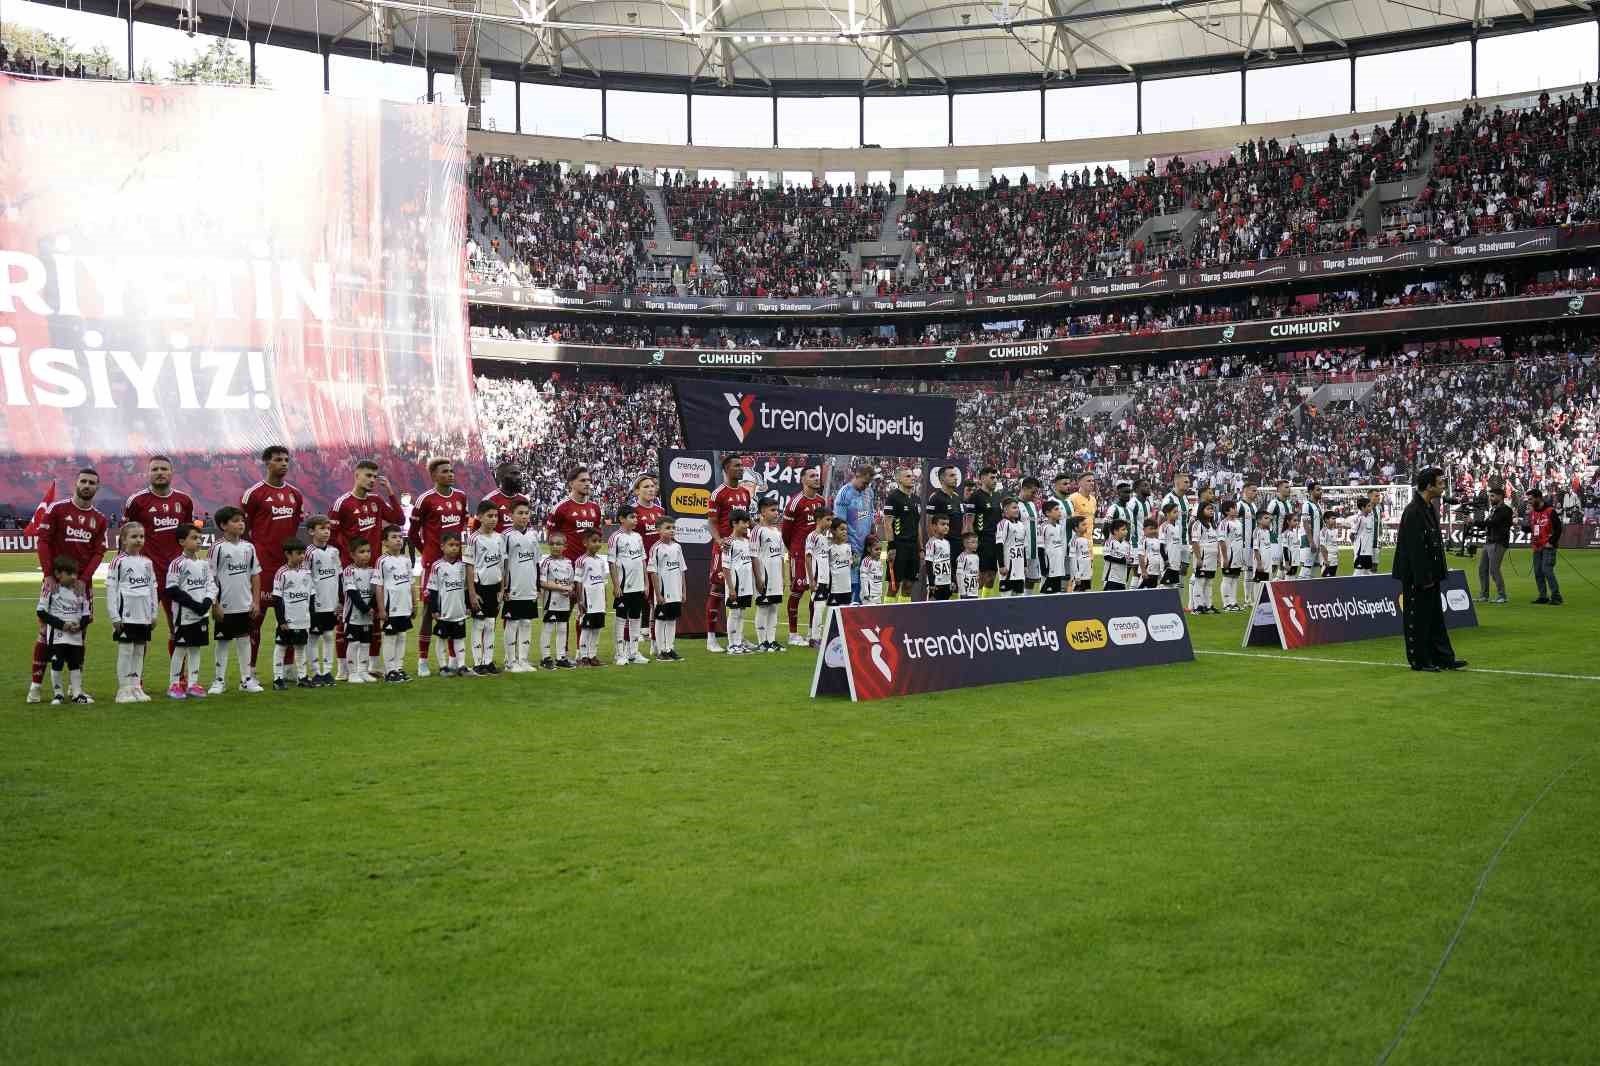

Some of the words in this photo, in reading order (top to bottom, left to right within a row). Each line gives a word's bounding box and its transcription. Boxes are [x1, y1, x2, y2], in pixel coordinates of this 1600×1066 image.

[1322, 259, 1345, 270] Tüpraş
[1346, 254, 1384, 267] Stadyumu
[1200, 273, 1221, 282] Tüpraş
[1222, 268, 1256, 281] Stadyumu
[760, 402, 854, 438] trendyol
[272, 506, 293, 515] beko
[153, 516, 179, 526] beko
[441, 514, 461, 523] beko
[66, 526, 92, 539] beko
[1306, 596, 1359, 621] trendyol
[903, 626, 994, 659] trendyol
